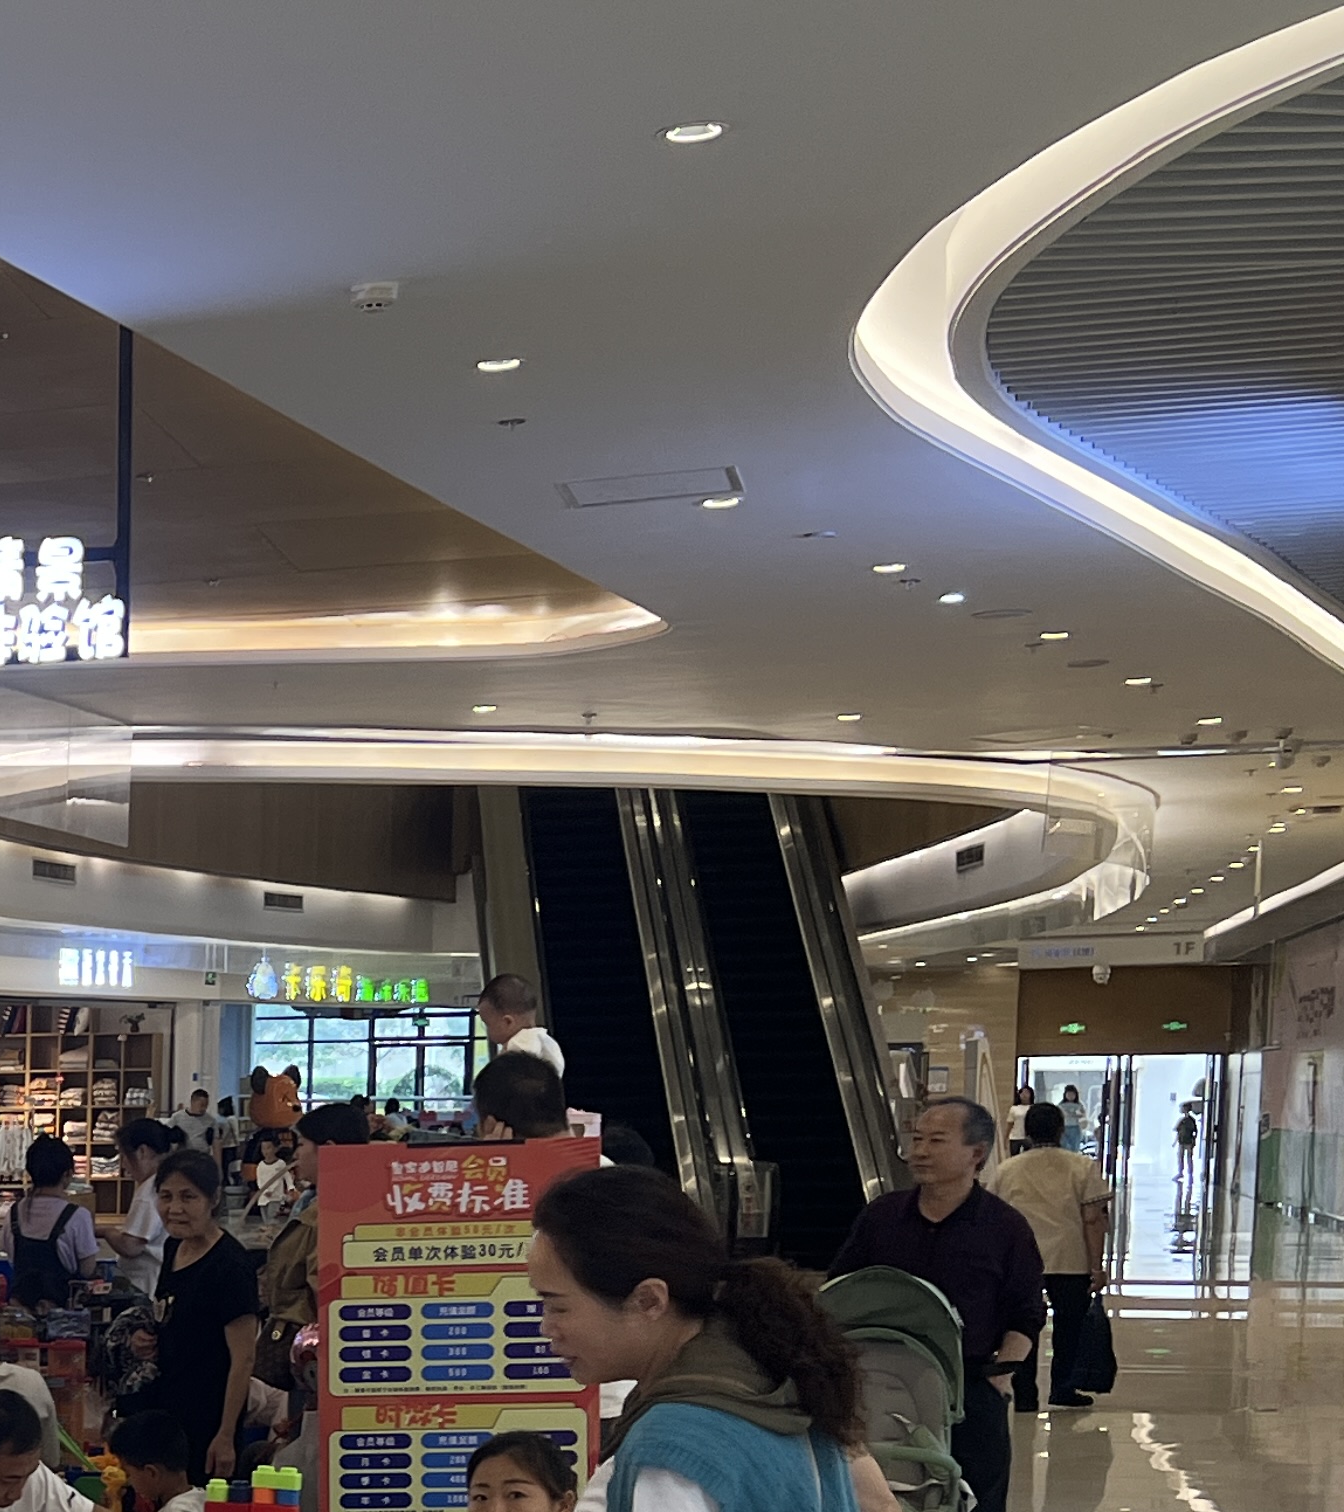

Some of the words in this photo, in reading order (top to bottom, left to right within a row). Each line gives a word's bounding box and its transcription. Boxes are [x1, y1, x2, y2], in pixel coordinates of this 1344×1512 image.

[1173, 941, 1195, 956] 1F
[462, 1154, 507, 1182] 会员
[386, 1178, 531, 1215] 收费标准
[373, 1242, 524, 1263] 会员单次体验30元/
